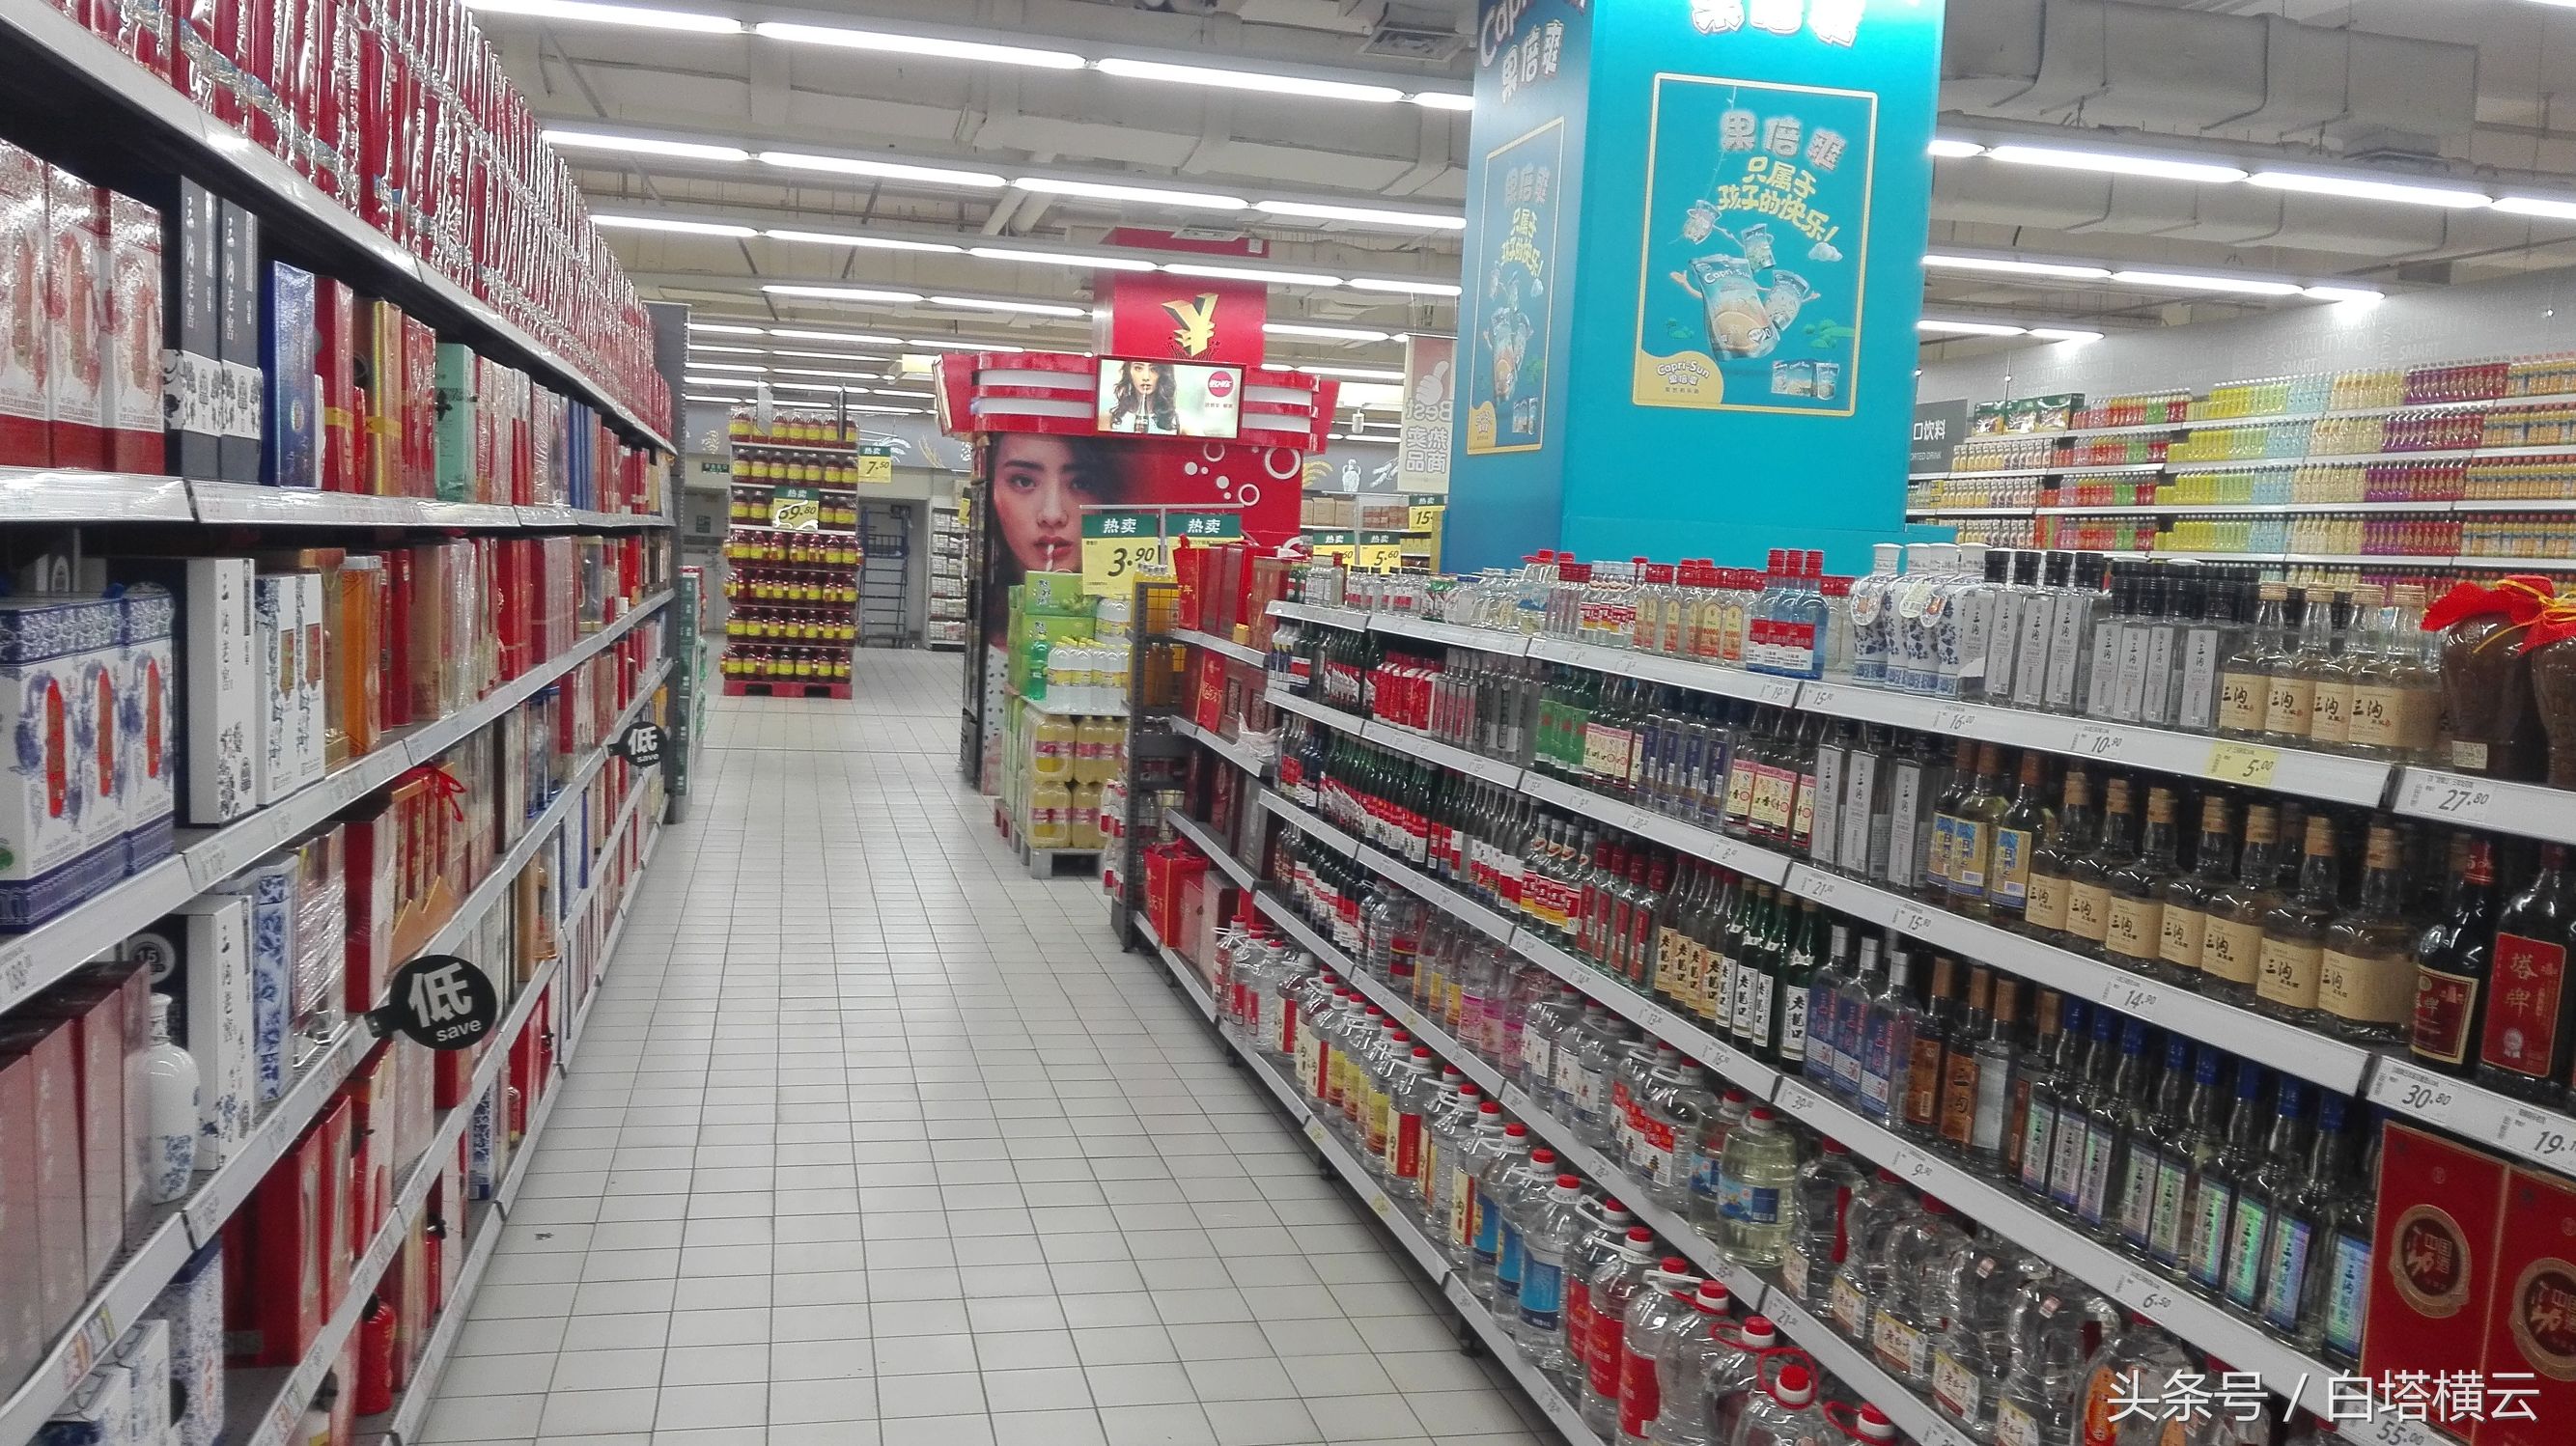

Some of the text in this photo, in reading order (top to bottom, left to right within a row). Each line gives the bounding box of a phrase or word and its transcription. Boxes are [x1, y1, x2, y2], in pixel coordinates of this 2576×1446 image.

[1501, 19, 1564, 103] 果倍爽
[1720, 109, 1847, 172] 果倍爽
[1746, 156, 1816, 198] 只属于
[1657, 360, 1710, 378] Capri-Sun
[866, 460, 889, 475] 7.50
[1103, 517, 1137, 534] 热卖
[1187, 517, 1221, 534] 热卖
[1107, 547, 1155, 577] 3.90
[1374, 550, 1399, 566] 5.60
[628, 725, 658, 755] 低
[637, 754, 659, 763] save
[2242, 759, 2274, 777] 5.00
[2438, 789, 2489, 812] 27.80
[407, 961, 473, 1028] 低
[435, 1019, 482, 1042] save
[2401, 1084, 2451, 1109] 30.80
